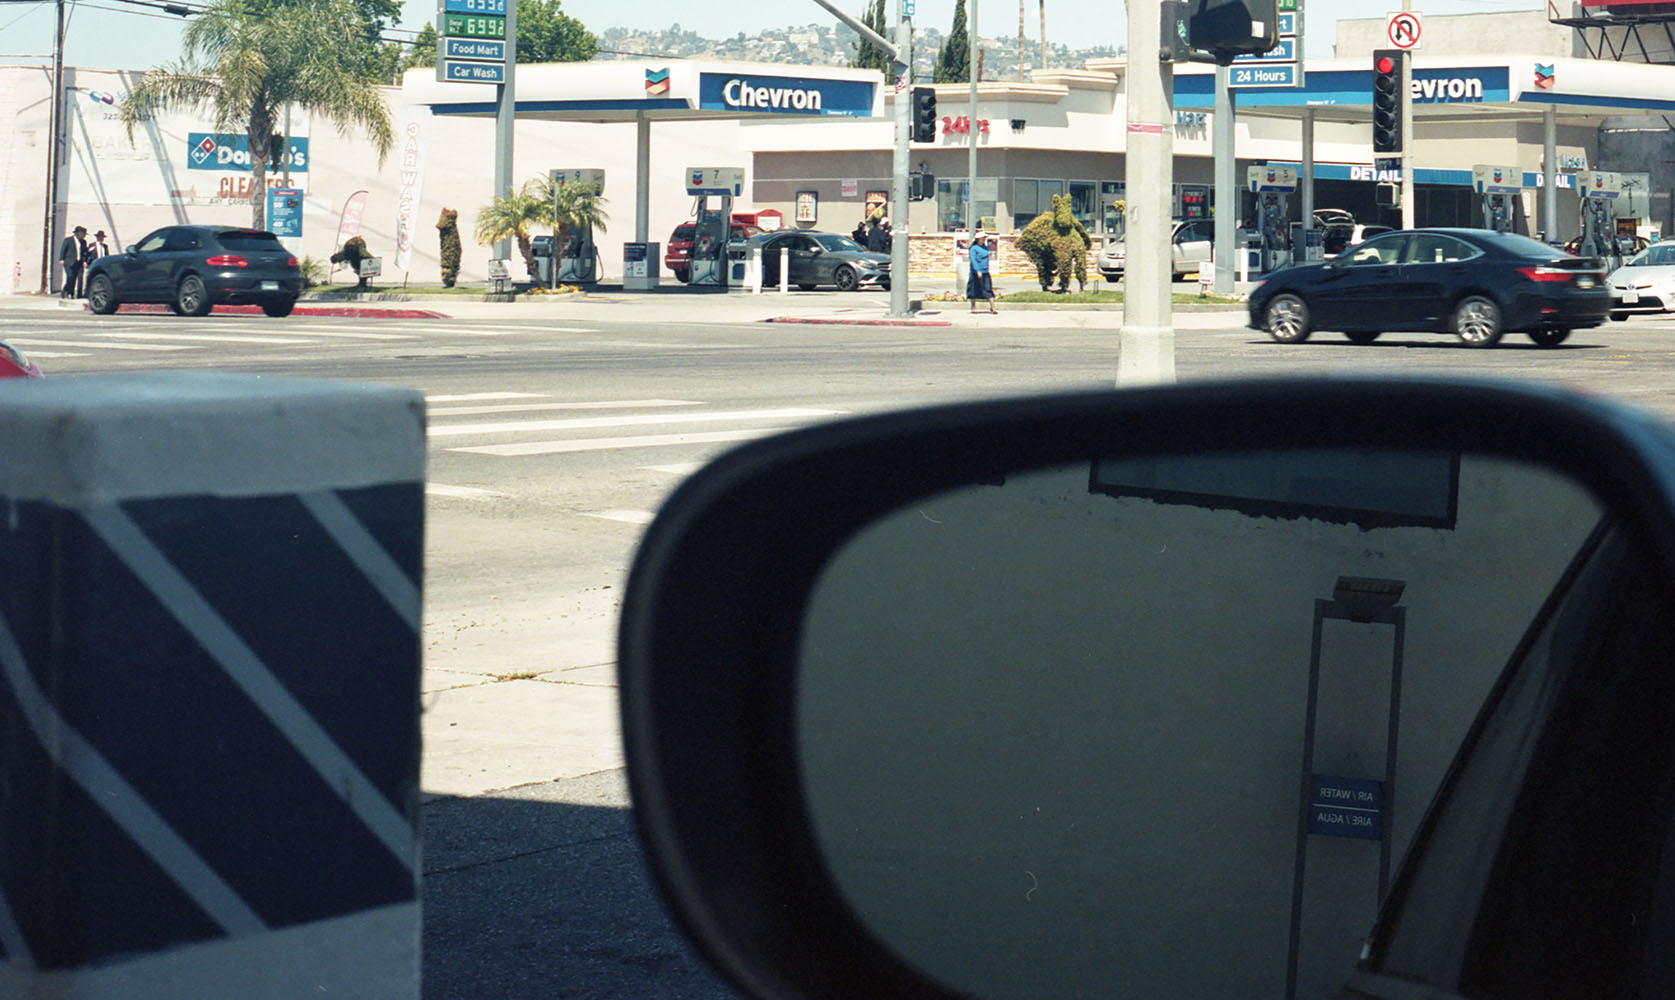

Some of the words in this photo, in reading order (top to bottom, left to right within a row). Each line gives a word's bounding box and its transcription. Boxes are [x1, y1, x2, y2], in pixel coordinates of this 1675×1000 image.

[453, 43, 474, 54] Food
[477, 45, 499, 56] Mart
[454, 67, 470, 77] Car
[473, 67, 497, 78] Wash
[1236, 70, 1251, 82] 24
[1254, 70, 1286, 82] Hours
[722, 79, 822, 110] Chevron
[1411, 77, 1483, 99] evron
[1351, 166, 1403, 182] DETAIL
